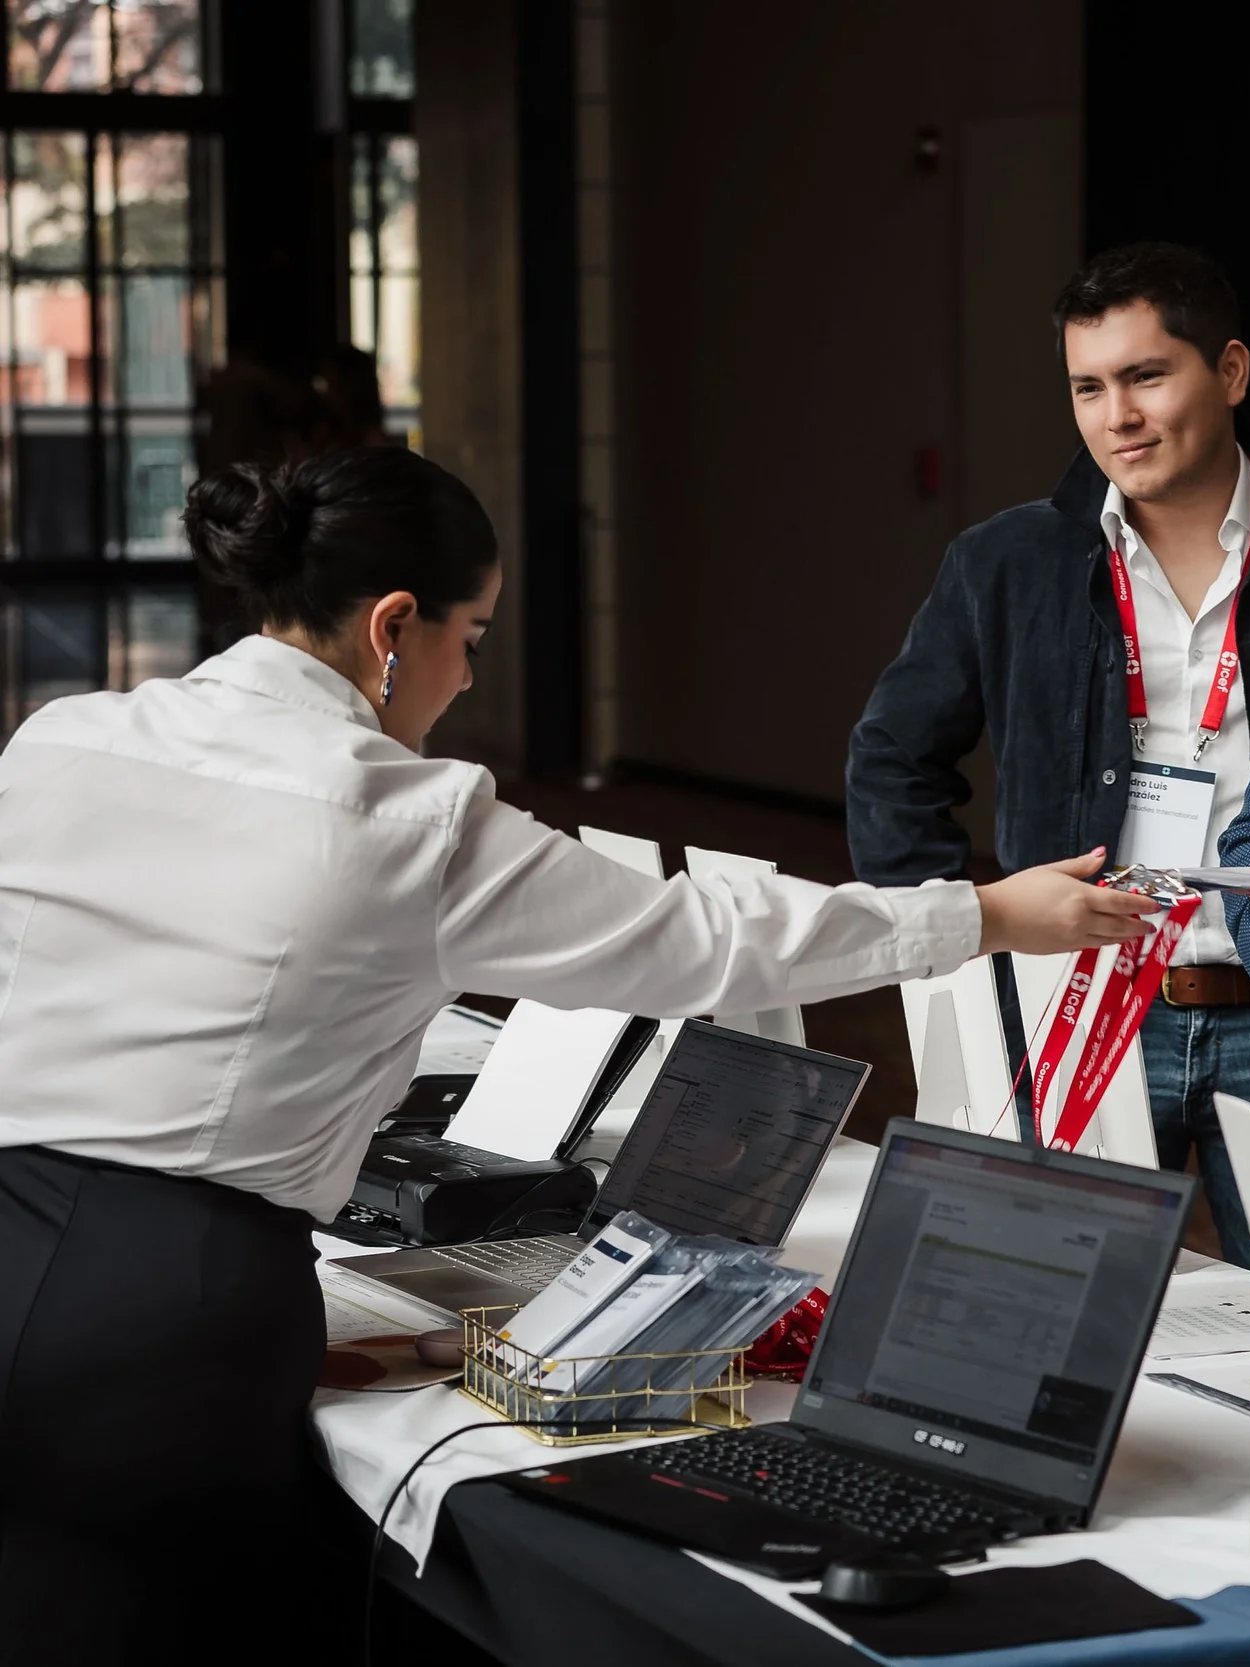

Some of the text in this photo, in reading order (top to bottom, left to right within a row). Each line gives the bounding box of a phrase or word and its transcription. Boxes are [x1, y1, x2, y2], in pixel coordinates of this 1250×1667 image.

[1217, 667, 1230, 694] icef
[1128, 789, 1161, 802] nzález
[1130, 778, 1168, 791] dro Luis
[1061, 991, 1082, 1025] icef
[1035, 1060, 1051, 1104] Connect.
